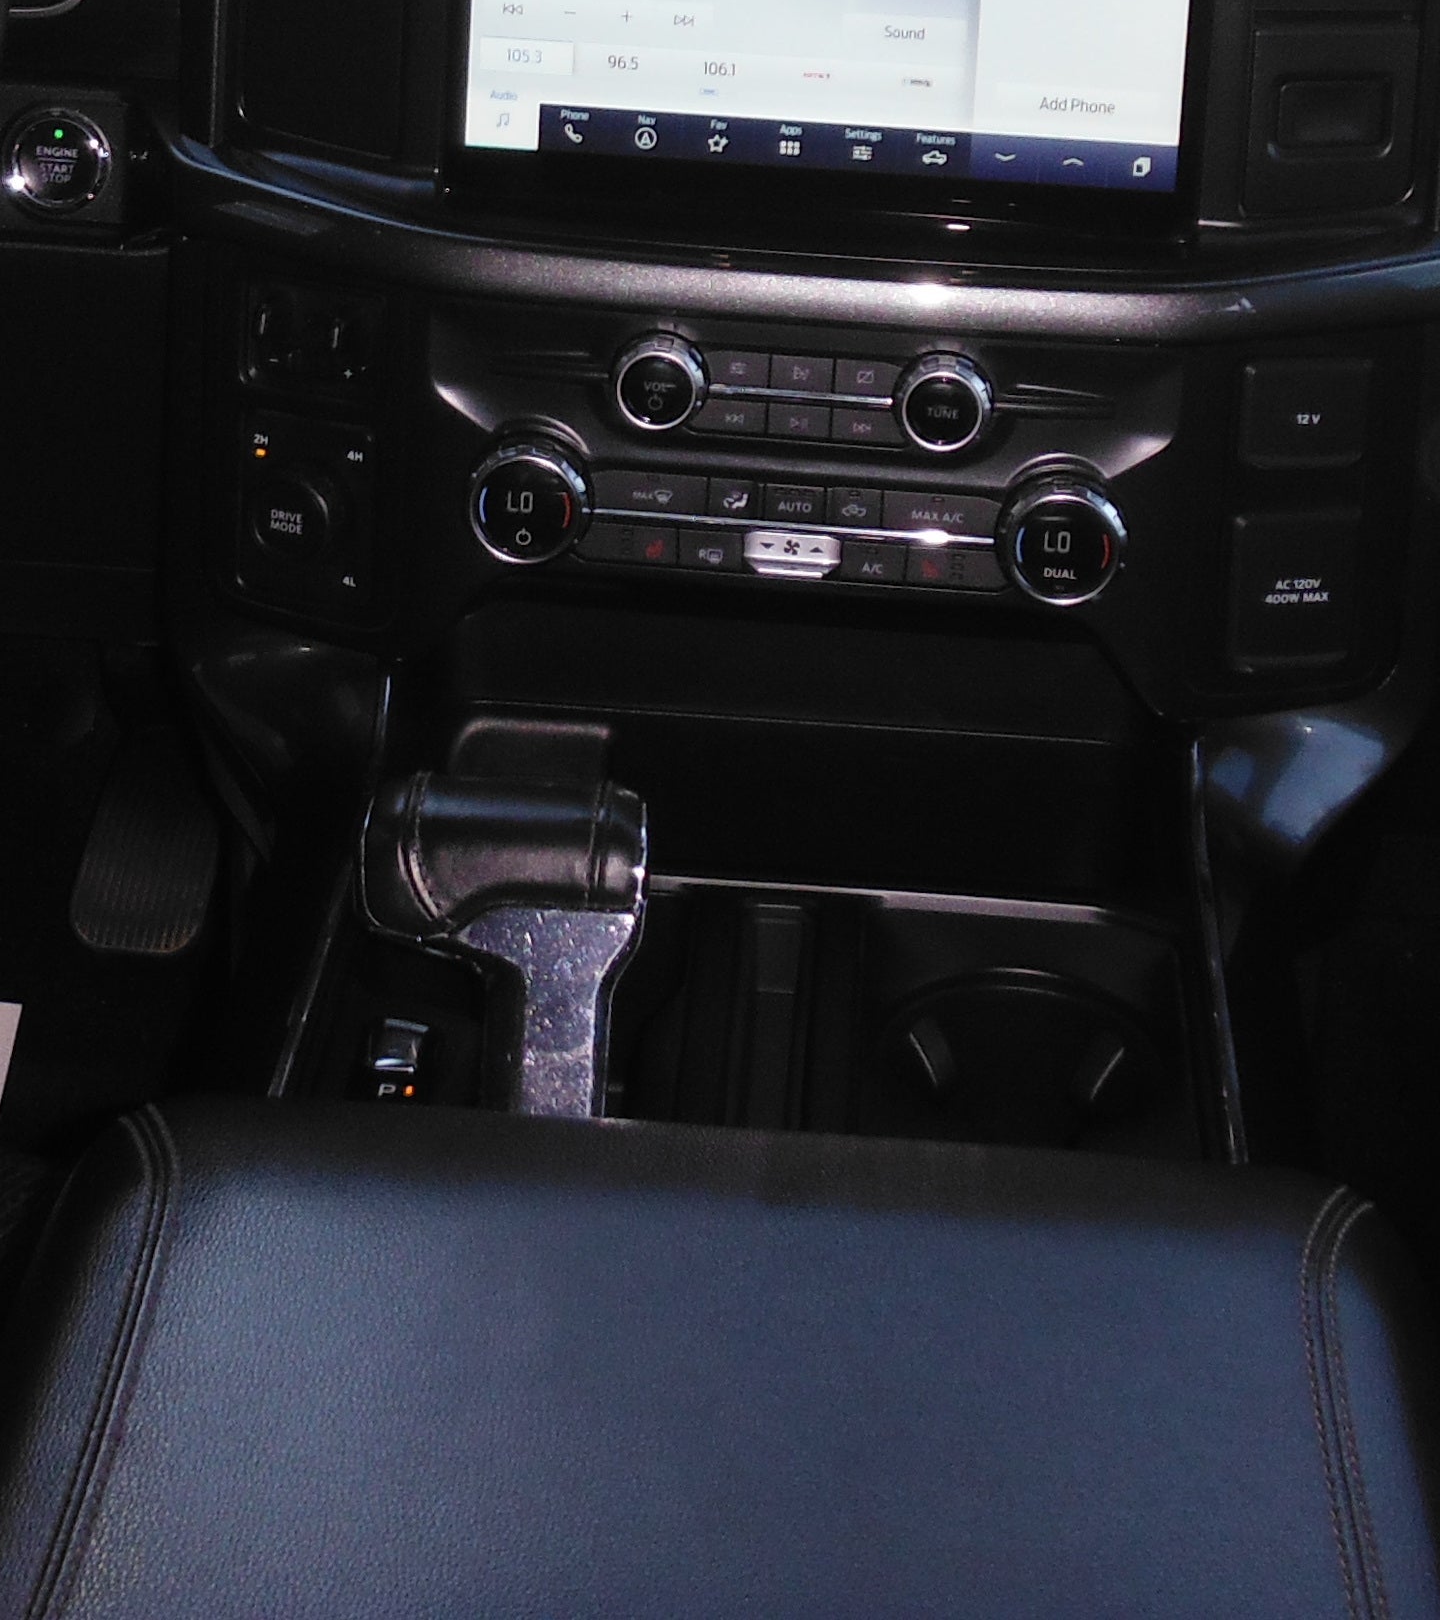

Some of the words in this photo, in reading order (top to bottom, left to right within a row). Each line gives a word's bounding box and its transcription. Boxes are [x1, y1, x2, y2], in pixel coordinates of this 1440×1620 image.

[884, 24, 927, 41] Sound
[507, 48, 543, 64] 105.3
[607, 55, 639, 71] 96.5
[703, 61, 737, 78] 106.1
[489, 90, 518, 101] Audio
[1040, 96, 1067, 113] Add
[1070, 98, 1116, 116] Phone
[560, 109, 590, 122] Phone
[638, 115, 656, 126] Nav
[710, 118, 728, 130] Fav
[779, 124, 803, 137] Apps
[844, 128, 883, 143] Settings
[916, 133, 955, 146] Features
[36, 146, 78, 158] ENGINE
[40, 163, 74, 174] START
[42, 174, 72, 184] STOP
[643, 381, 669, 392] VOL
[926, 406, 960, 421] TUNE
[1296, 413, 1310, 425] 12
[1312, 414, 1321, 425] V
[253, 433, 269, 446] 2H
[346, 450, 364, 463] 4H
[506, 490, 534, 513] LO
[632, 491, 654, 500] MAX
[777, 501, 812, 514] AUTO
[270, 509, 303, 523] DRIVE
[911, 509, 940, 522] MAX
[942, 512, 964, 524] A/C
[270, 520, 303, 535] MODE
[1043, 530, 1071, 554] LO
[861, 562, 884, 575] A/C
[1043, 567, 1077, 580] DUAL
[342, 576, 357, 588] 4L
[1275, 579, 1290, 590] AC
[1293, 578, 1322, 590] 120V
[1264, 592, 1300, 605] 400W
[1302, 591, 1330, 603] MAX
[378, 1084, 396, 1096] P
